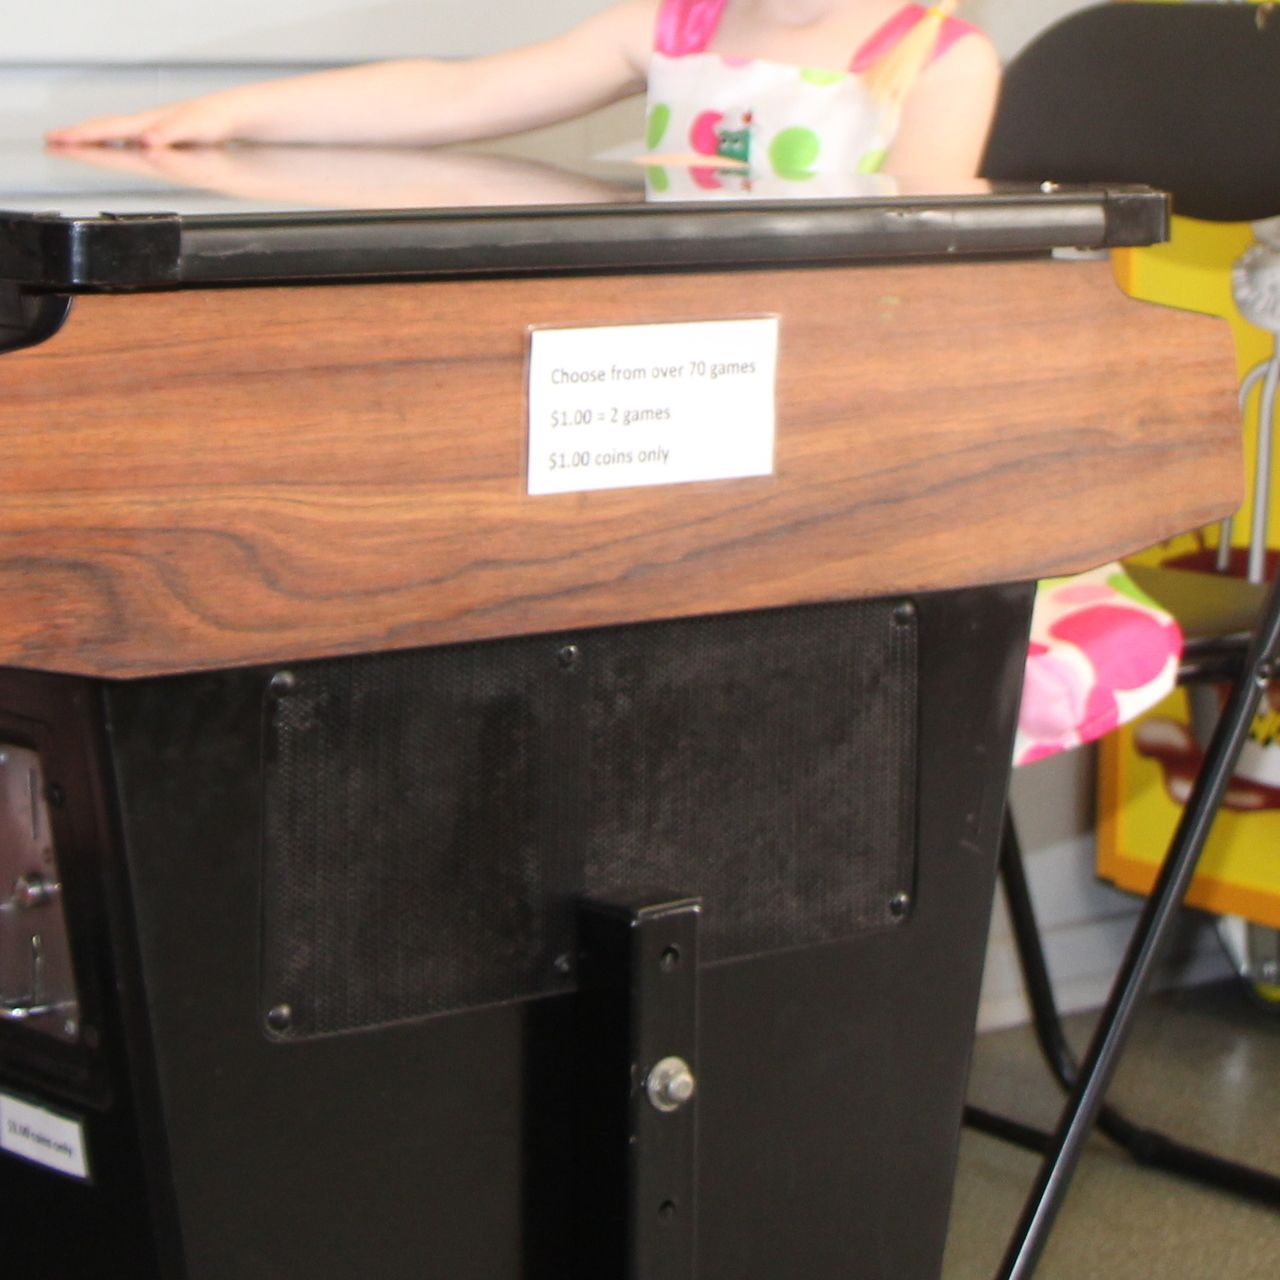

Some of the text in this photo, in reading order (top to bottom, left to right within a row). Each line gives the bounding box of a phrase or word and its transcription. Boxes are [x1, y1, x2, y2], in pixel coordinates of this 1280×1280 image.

[550, 361, 756, 385] Choose from over 70 games
[550, 409, 592, 428] $1.00
[610, 407, 618, 423] 2
[623, 407, 671, 425] games
[548, 445, 670, 470] $1.00 coins only
